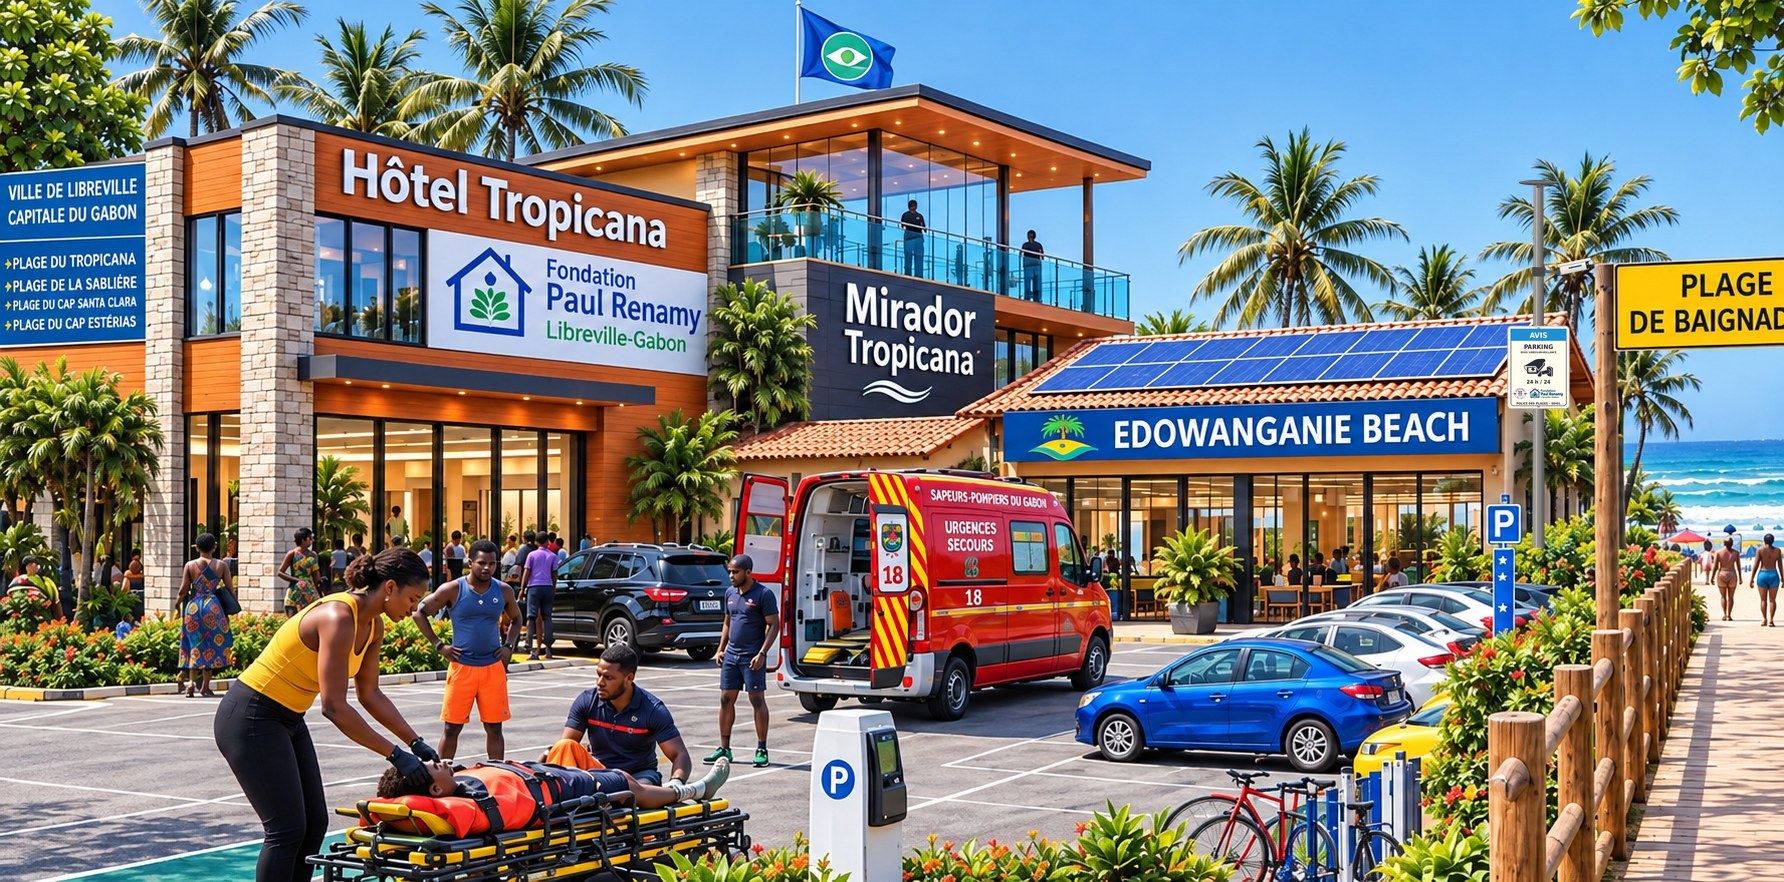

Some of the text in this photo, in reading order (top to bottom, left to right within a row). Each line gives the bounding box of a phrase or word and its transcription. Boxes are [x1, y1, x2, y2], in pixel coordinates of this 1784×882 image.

[8, 178, 137, 200] VILLE DE LIBREVILLE
[343, 149, 666, 249] Hôtel Tropicana
[8, 204, 137, 225] CAPITALE DU GABON
[13, 252, 136, 270] PLAGE DU TROPICANA
[13, 280, 47, 292] PLAGE
[51, 279, 65, 291] DE
[69, 278, 82, 290] LA
[547, 259, 636, 290] Fondation
[1682, 272, 1772, 298] PLAGE
[13, 297, 136, 310] PLAGE DU CAP SANTA CLARA
[547, 282, 701, 335] Paul Renamy
[846, 283, 976, 338] Mirador
[13, 314, 136, 331] PLAGE DU CAP ESTÉRIAS
[1631, 310, 1664, 334] DE
[547, 321, 686, 352] Libreville-Gabon
[844, 329, 974, 376] Tropicana
[1114, 411, 1470, 449] EDOWANGANIE BEACH
[1011, 496, 1021, 506] DU
[1024, 497, 1047, 508] GABON
[945, 521, 997, 534] URGENCES
[1495, 510, 1514, 537] P
[948, 538, 994, 551] SECOURS
[883, 566, 903, 584] 18
[965, 589, 982, 605] 18
[831, 766, 848, 794] P
